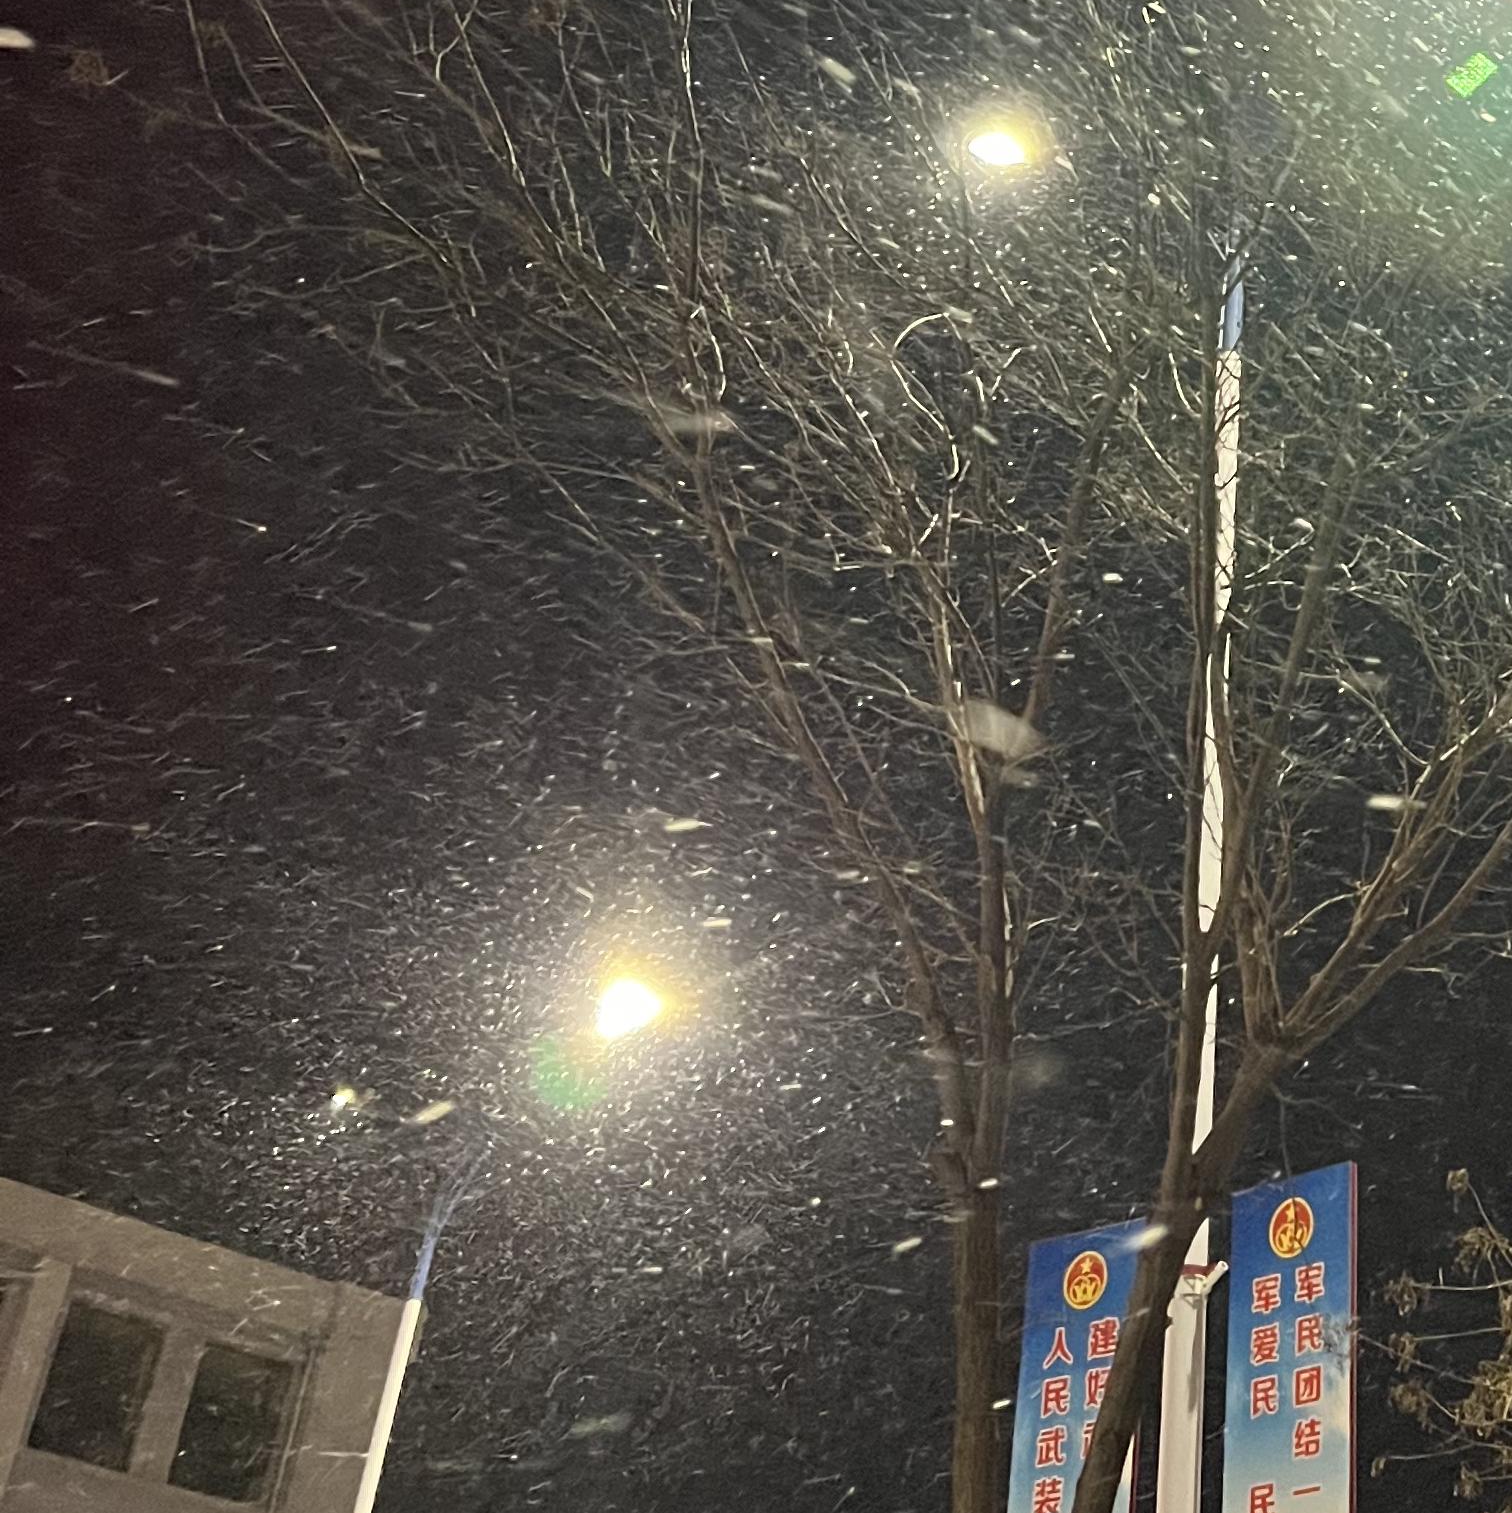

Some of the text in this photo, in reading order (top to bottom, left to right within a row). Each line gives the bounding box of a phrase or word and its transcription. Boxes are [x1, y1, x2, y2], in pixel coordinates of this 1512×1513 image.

[1031, 1327, 1073, 1513] 人民武装
[1250, 1273, 1281, 1420] 军爱民
[1292, 1262, 1325, 1497] 军民团结一
